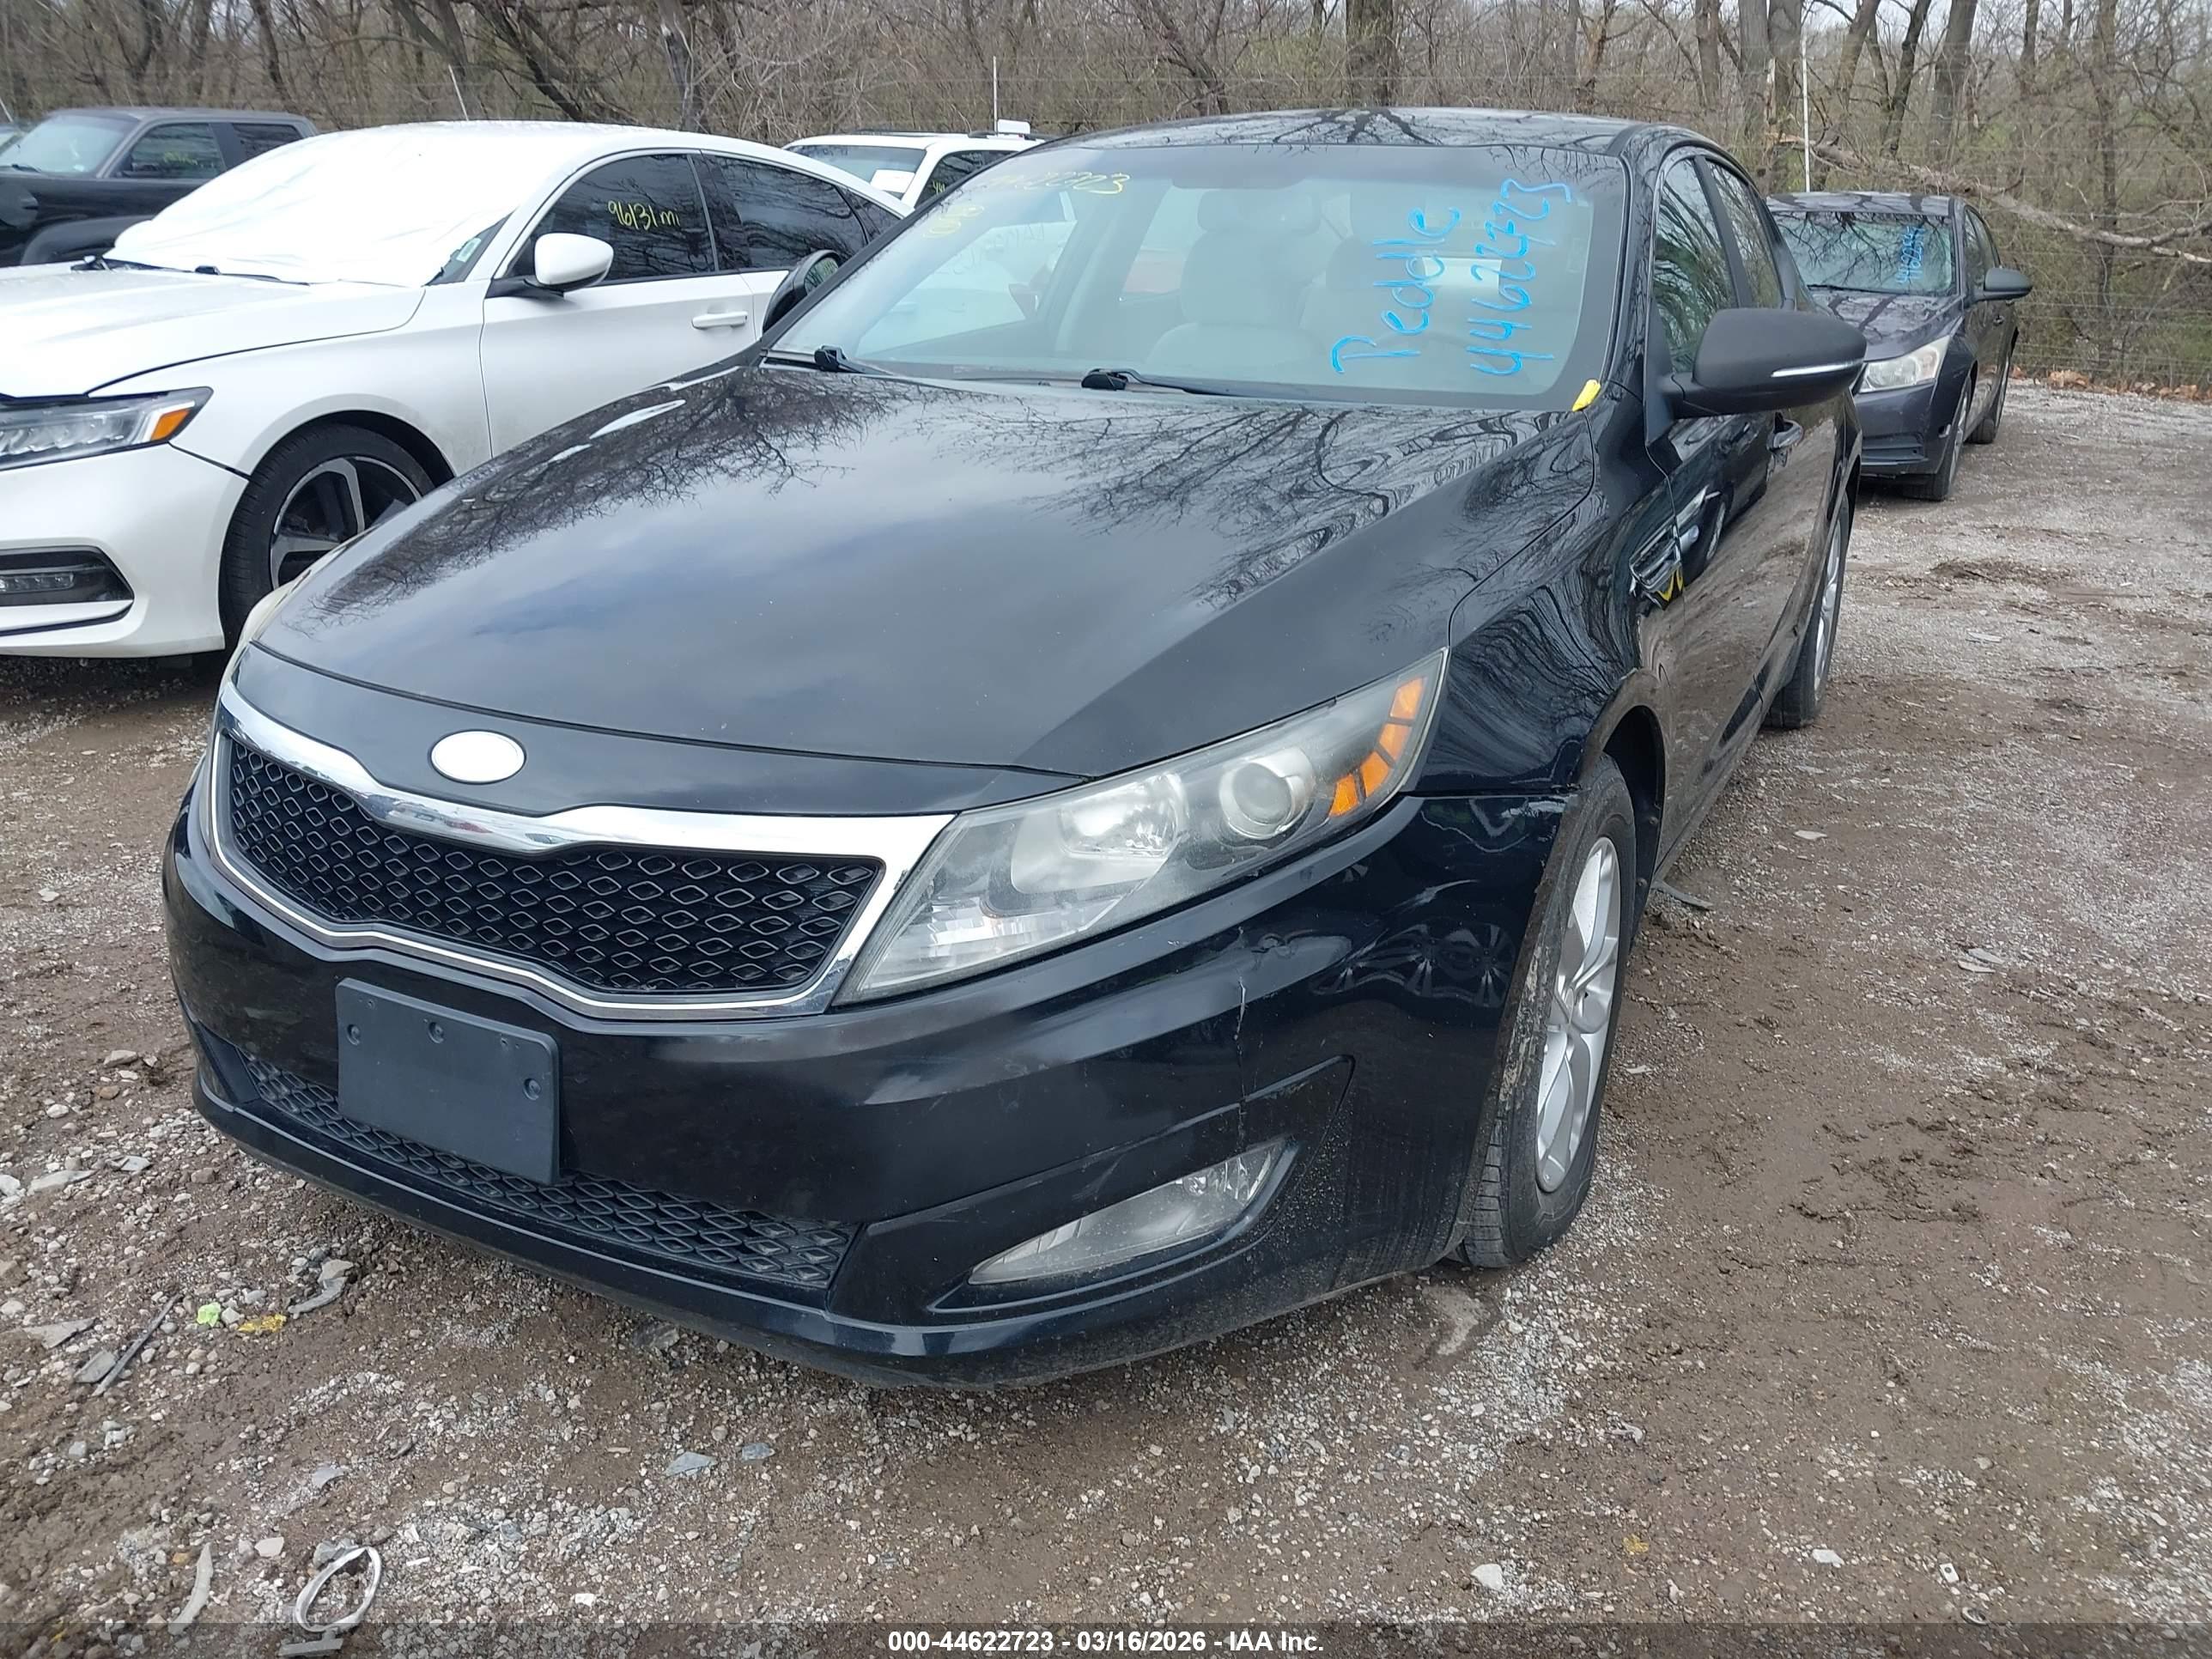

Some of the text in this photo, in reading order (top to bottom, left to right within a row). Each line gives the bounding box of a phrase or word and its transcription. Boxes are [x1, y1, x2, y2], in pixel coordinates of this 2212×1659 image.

[608, 201, 680, 231] 96131 mi
[1330, 208, 1462, 374] Peddle
[1465, 179, 1572, 375] 44622723
